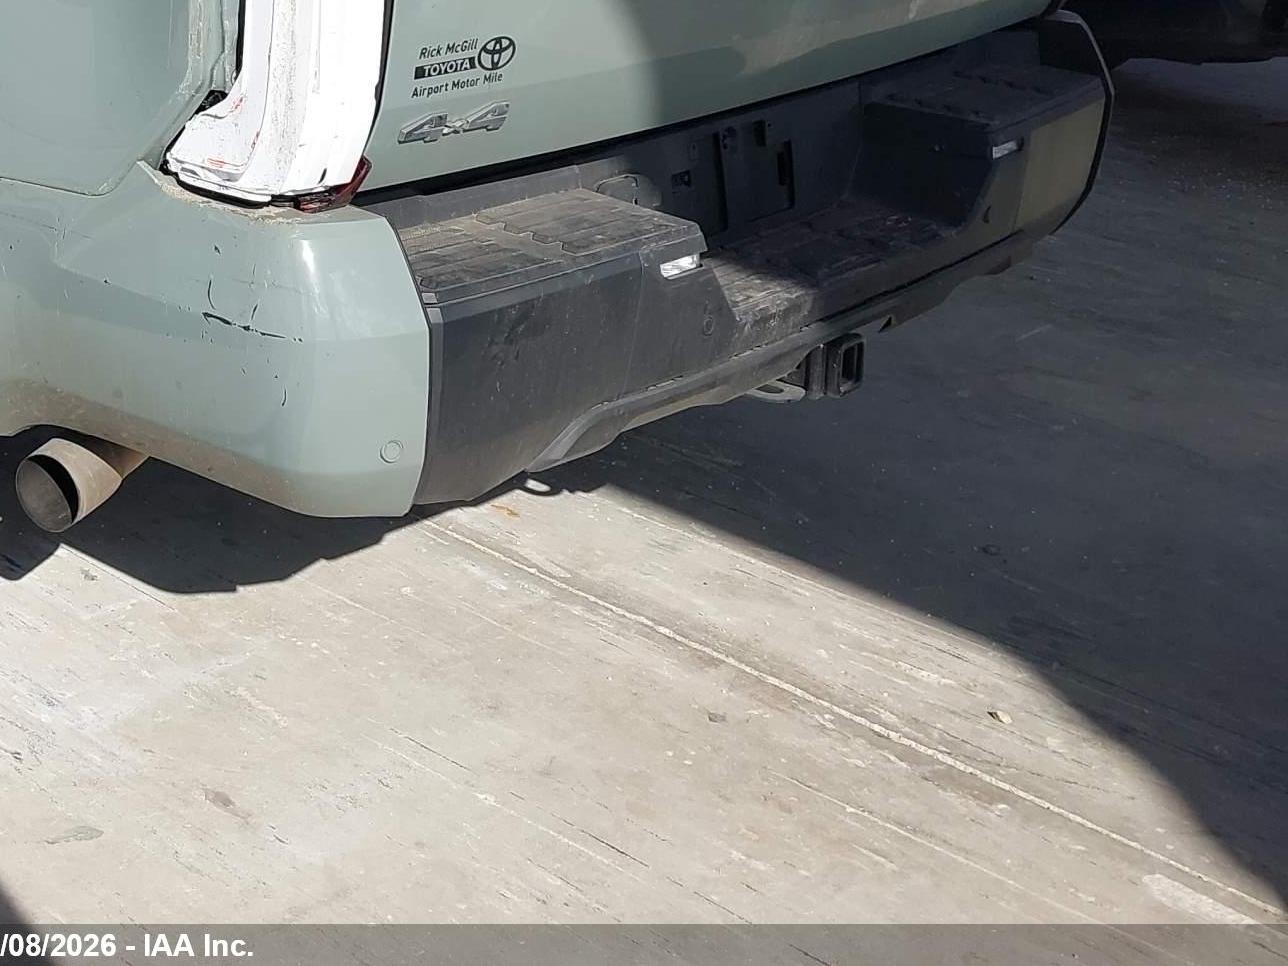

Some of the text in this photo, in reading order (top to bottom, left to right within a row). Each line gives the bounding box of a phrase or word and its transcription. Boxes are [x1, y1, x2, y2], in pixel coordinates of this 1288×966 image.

[419, 38, 478, 59] Rick McGill
[423, 59, 471, 77] TOYOTA
[411, 72, 503, 98] Airport Motor Mile
